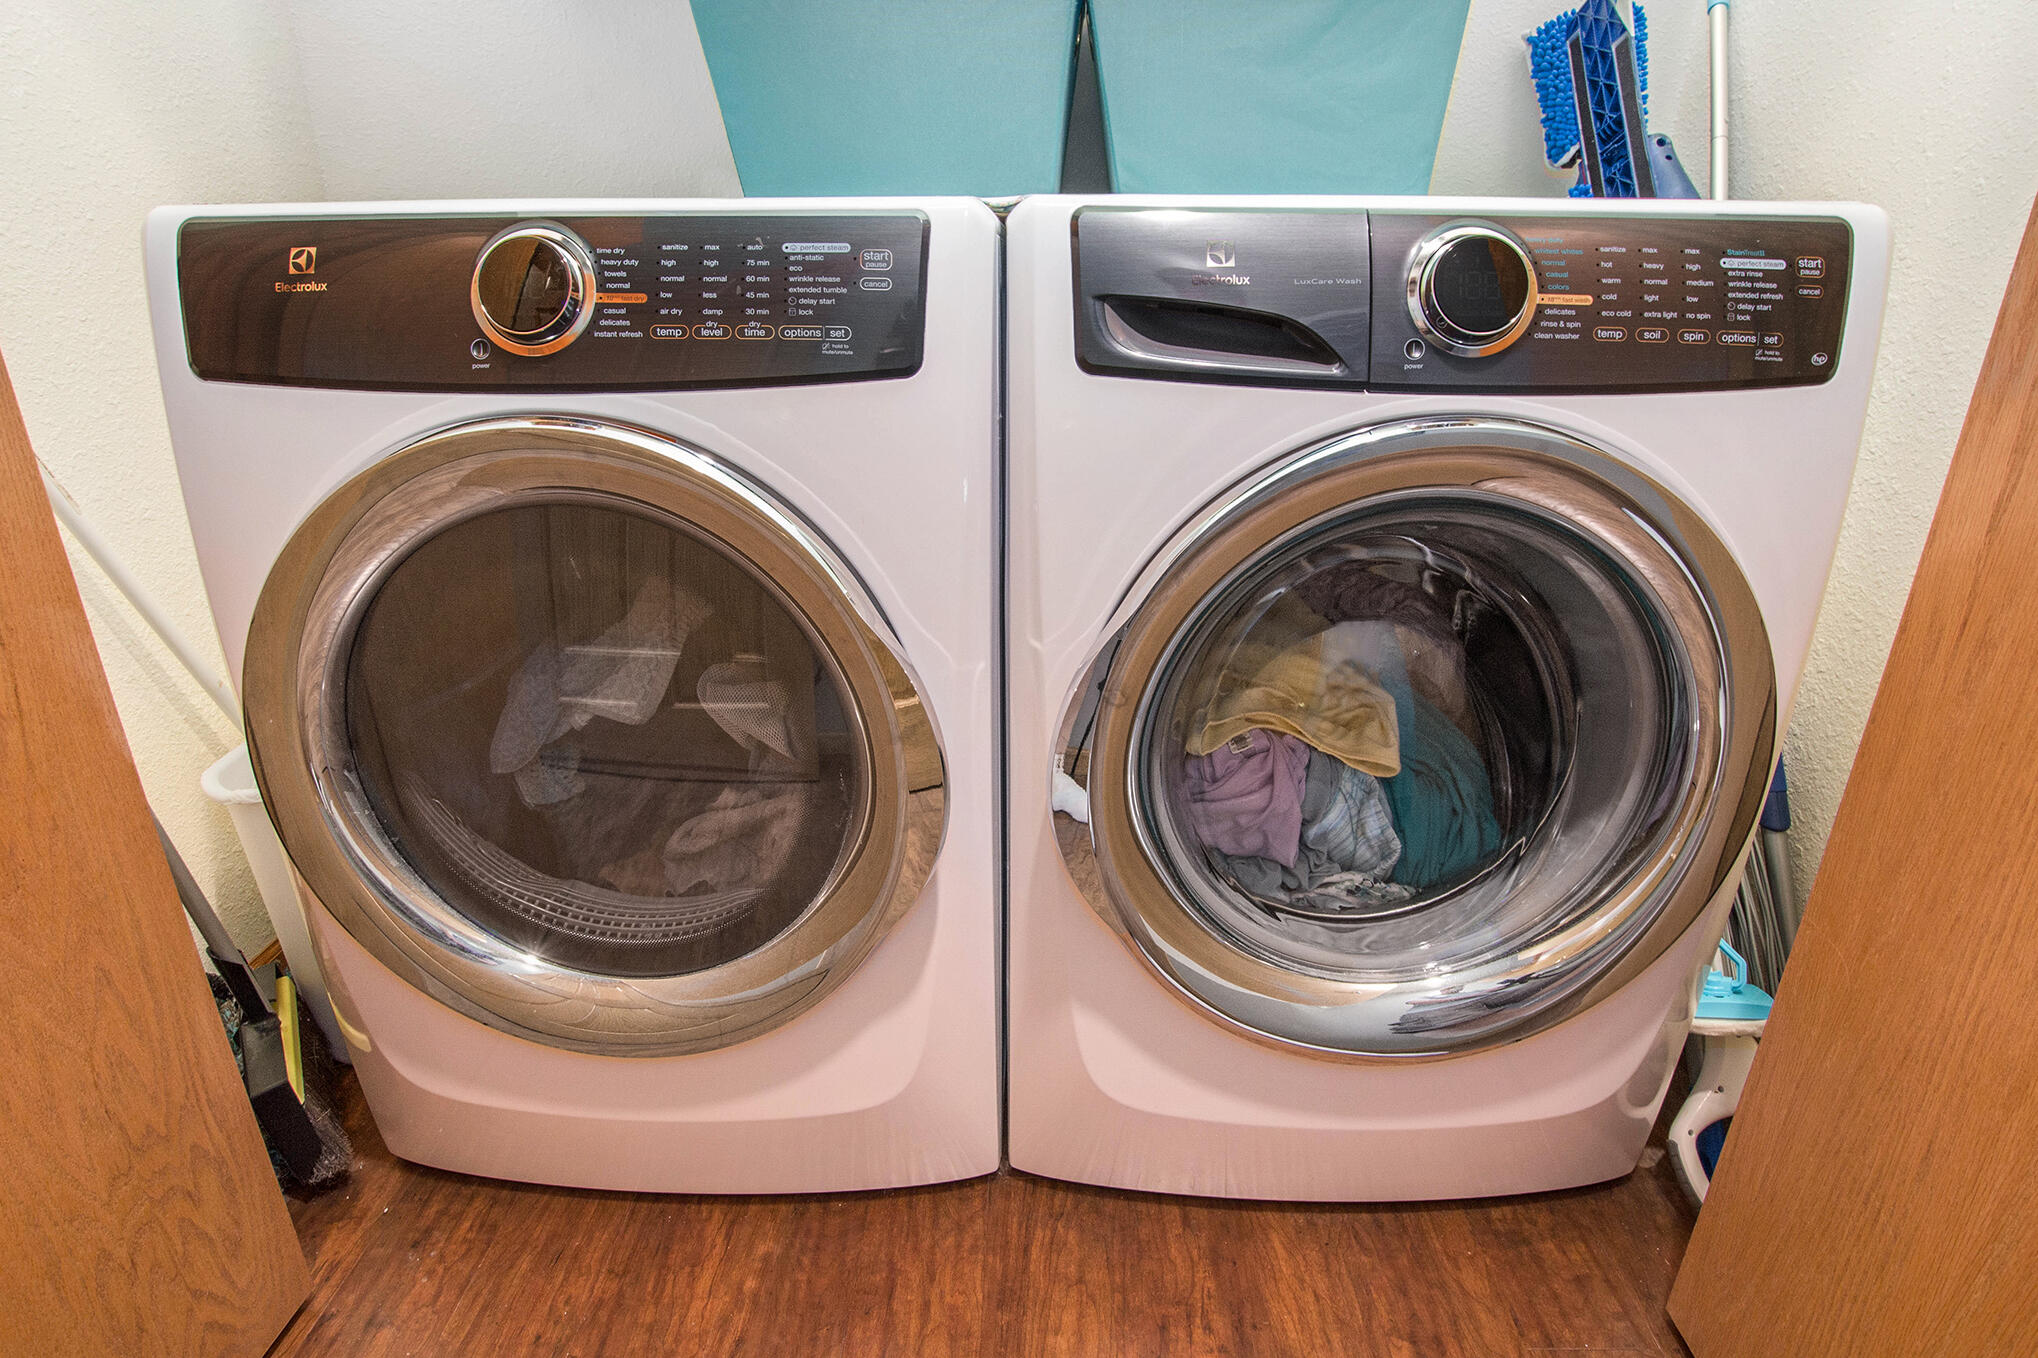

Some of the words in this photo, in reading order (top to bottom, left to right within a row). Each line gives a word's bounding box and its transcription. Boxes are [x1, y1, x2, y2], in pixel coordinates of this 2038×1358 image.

[613, 247, 625, 256] dry
[800, 244, 826, 253] perfect
[863, 251, 889, 261] start
[601, 259, 621, 267] heavy
[623, 259, 639, 267] duty
[661, 259, 676, 267] high
[704, 259, 719, 267] high
[1643, 262, 1664, 270] heavy
[1686, 263, 1700, 271] high
[1737, 260, 1762, 268] perfect
[1799, 258, 1822, 268] start
[864, 280, 888, 288] cancel
[1192, 275, 1250, 286] Electrolux
[275, 281, 328, 293] Electrolux
[1799, 287, 1820, 295] cancel
[1644, 294, 1659, 303] light
[1761, 292, 1783, 300] refresh
[799, 298, 818, 306] delay
[1738, 303, 1755, 312] delay
[671, 308, 682, 316] dry
[703, 308, 723, 316] damp
[799, 308, 813, 316] lock
[1663, 311, 1677, 319] light
[1696, 313, 1711, 321] spin
[1566, 321, 1581, 329] spin
[657, 327, 682, 337] temp
[701, 327, 723, 337] level
[745, 328, 765, 337] time
[784, 327, 822, 339] options
[830, 328, 845, 338] set
[1598, 330, 1622, 339] temp
[1644, 331, 1661, 339] soil
[1684, 332, 1704, 342] spin
[1722, 334, 1756, 345] options
[1764, 335, 1778, 344] set
